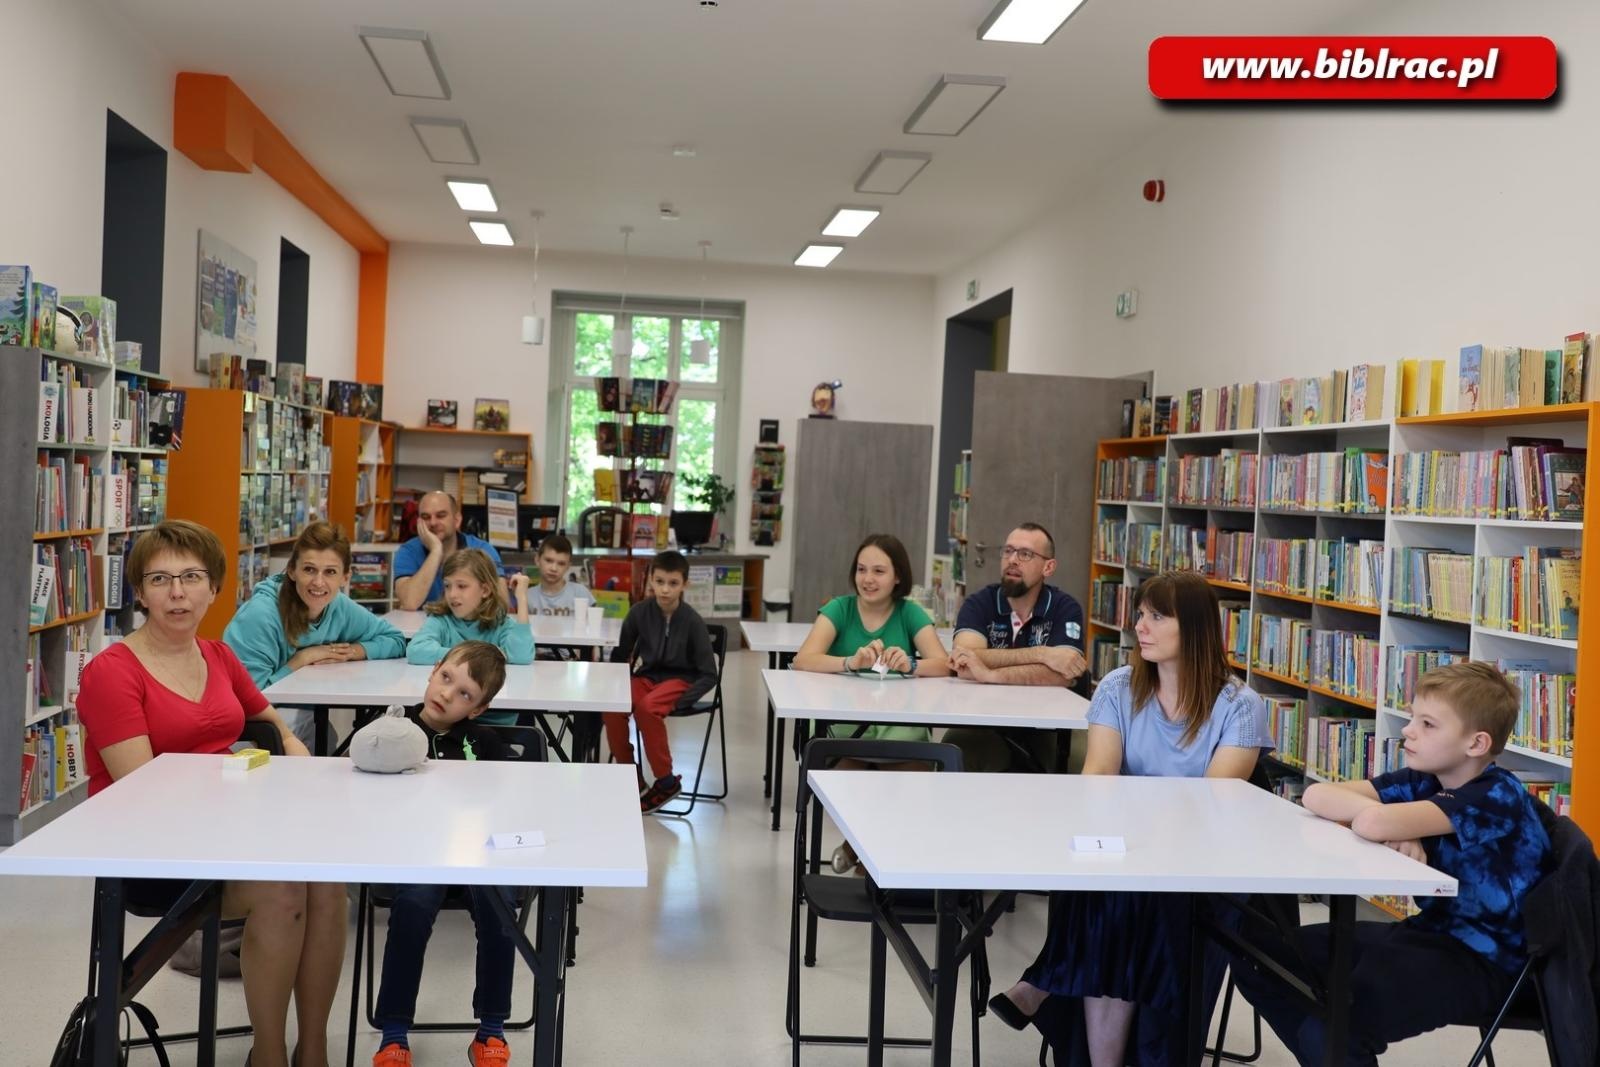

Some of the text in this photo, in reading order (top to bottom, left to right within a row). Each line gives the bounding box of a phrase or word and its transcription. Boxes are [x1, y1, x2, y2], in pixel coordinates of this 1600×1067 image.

[43, 400, 52, 440] EKOLOGIA
[32, 568, 44, 604] PLASTYCZNE
[41, 578, 50, 597] PRACE
[66, 744, 76, 779] HOBBY
[515, 835, 524, 845] 2
[1096, 839, 1103, 849] 1
